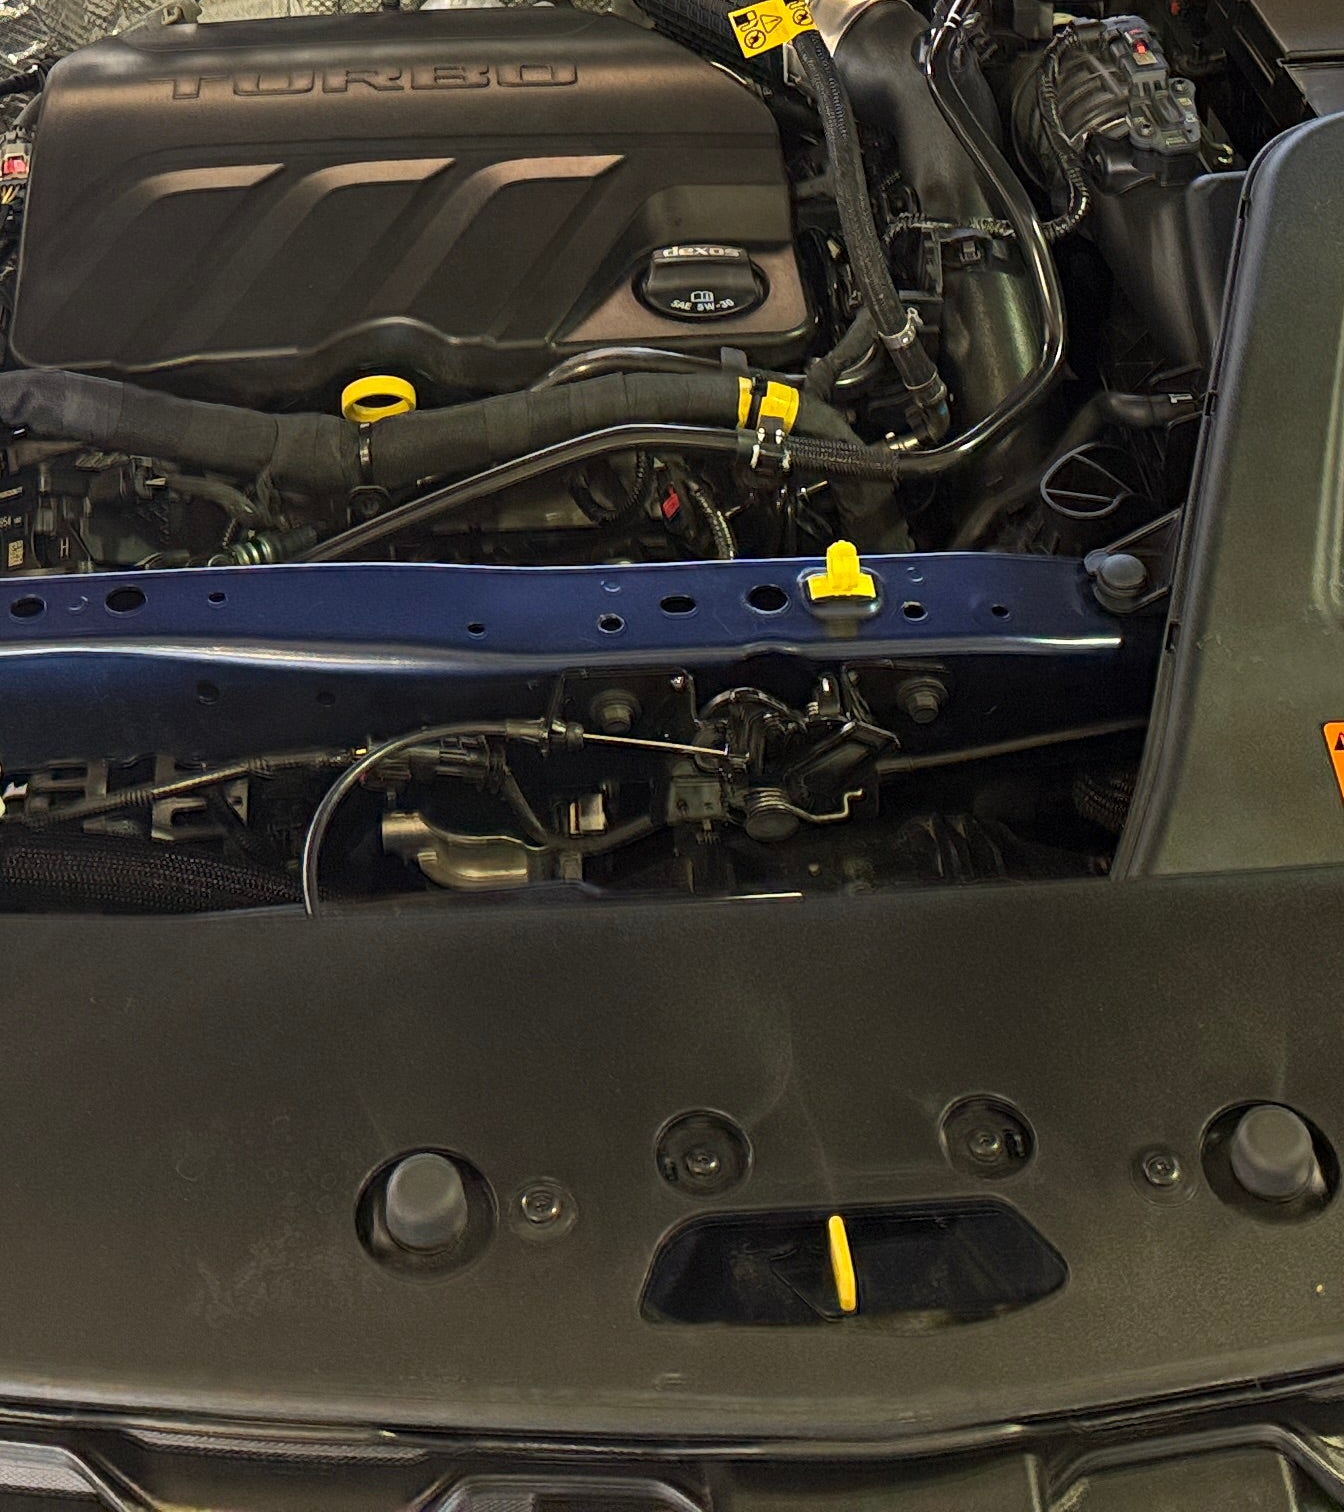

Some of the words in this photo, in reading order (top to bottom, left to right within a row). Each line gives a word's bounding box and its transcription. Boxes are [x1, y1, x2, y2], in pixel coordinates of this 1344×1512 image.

[149, 63, 579, 100] TURBO
[662, 246, 742, 257] dexos
[671, 299, 692, 310] SAE
